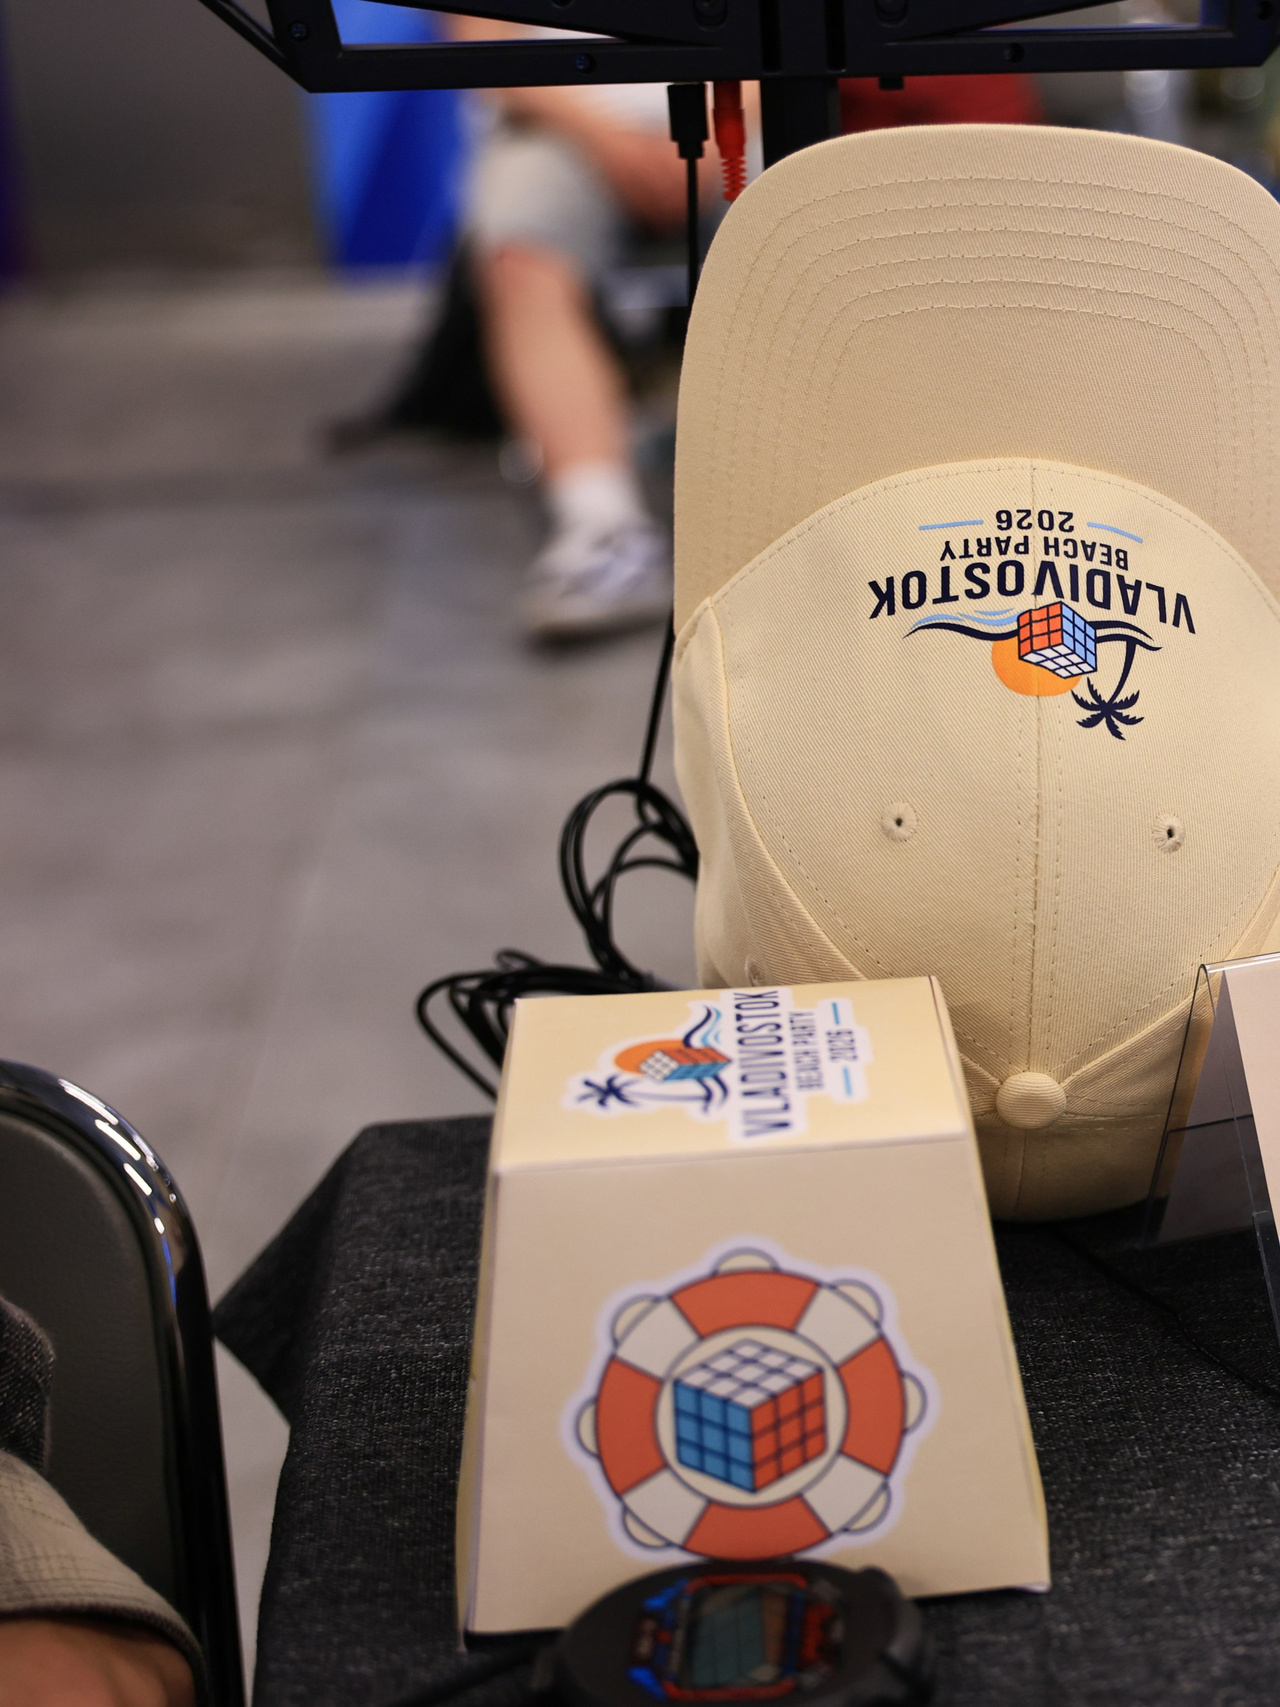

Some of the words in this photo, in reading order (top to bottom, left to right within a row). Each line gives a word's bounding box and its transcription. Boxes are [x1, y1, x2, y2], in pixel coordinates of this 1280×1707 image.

[995, 509, 1074, 533] 2026
[940, 535, 1030, 561] PARTY
[1043, 536, 1129, 571] BEACH
[868, 559, 1196, 634] VLADIVOSTOK
[790, 1012, 818, 1045] PARTY
[734, 991, 790, 1137] VLADIVOSTOK
